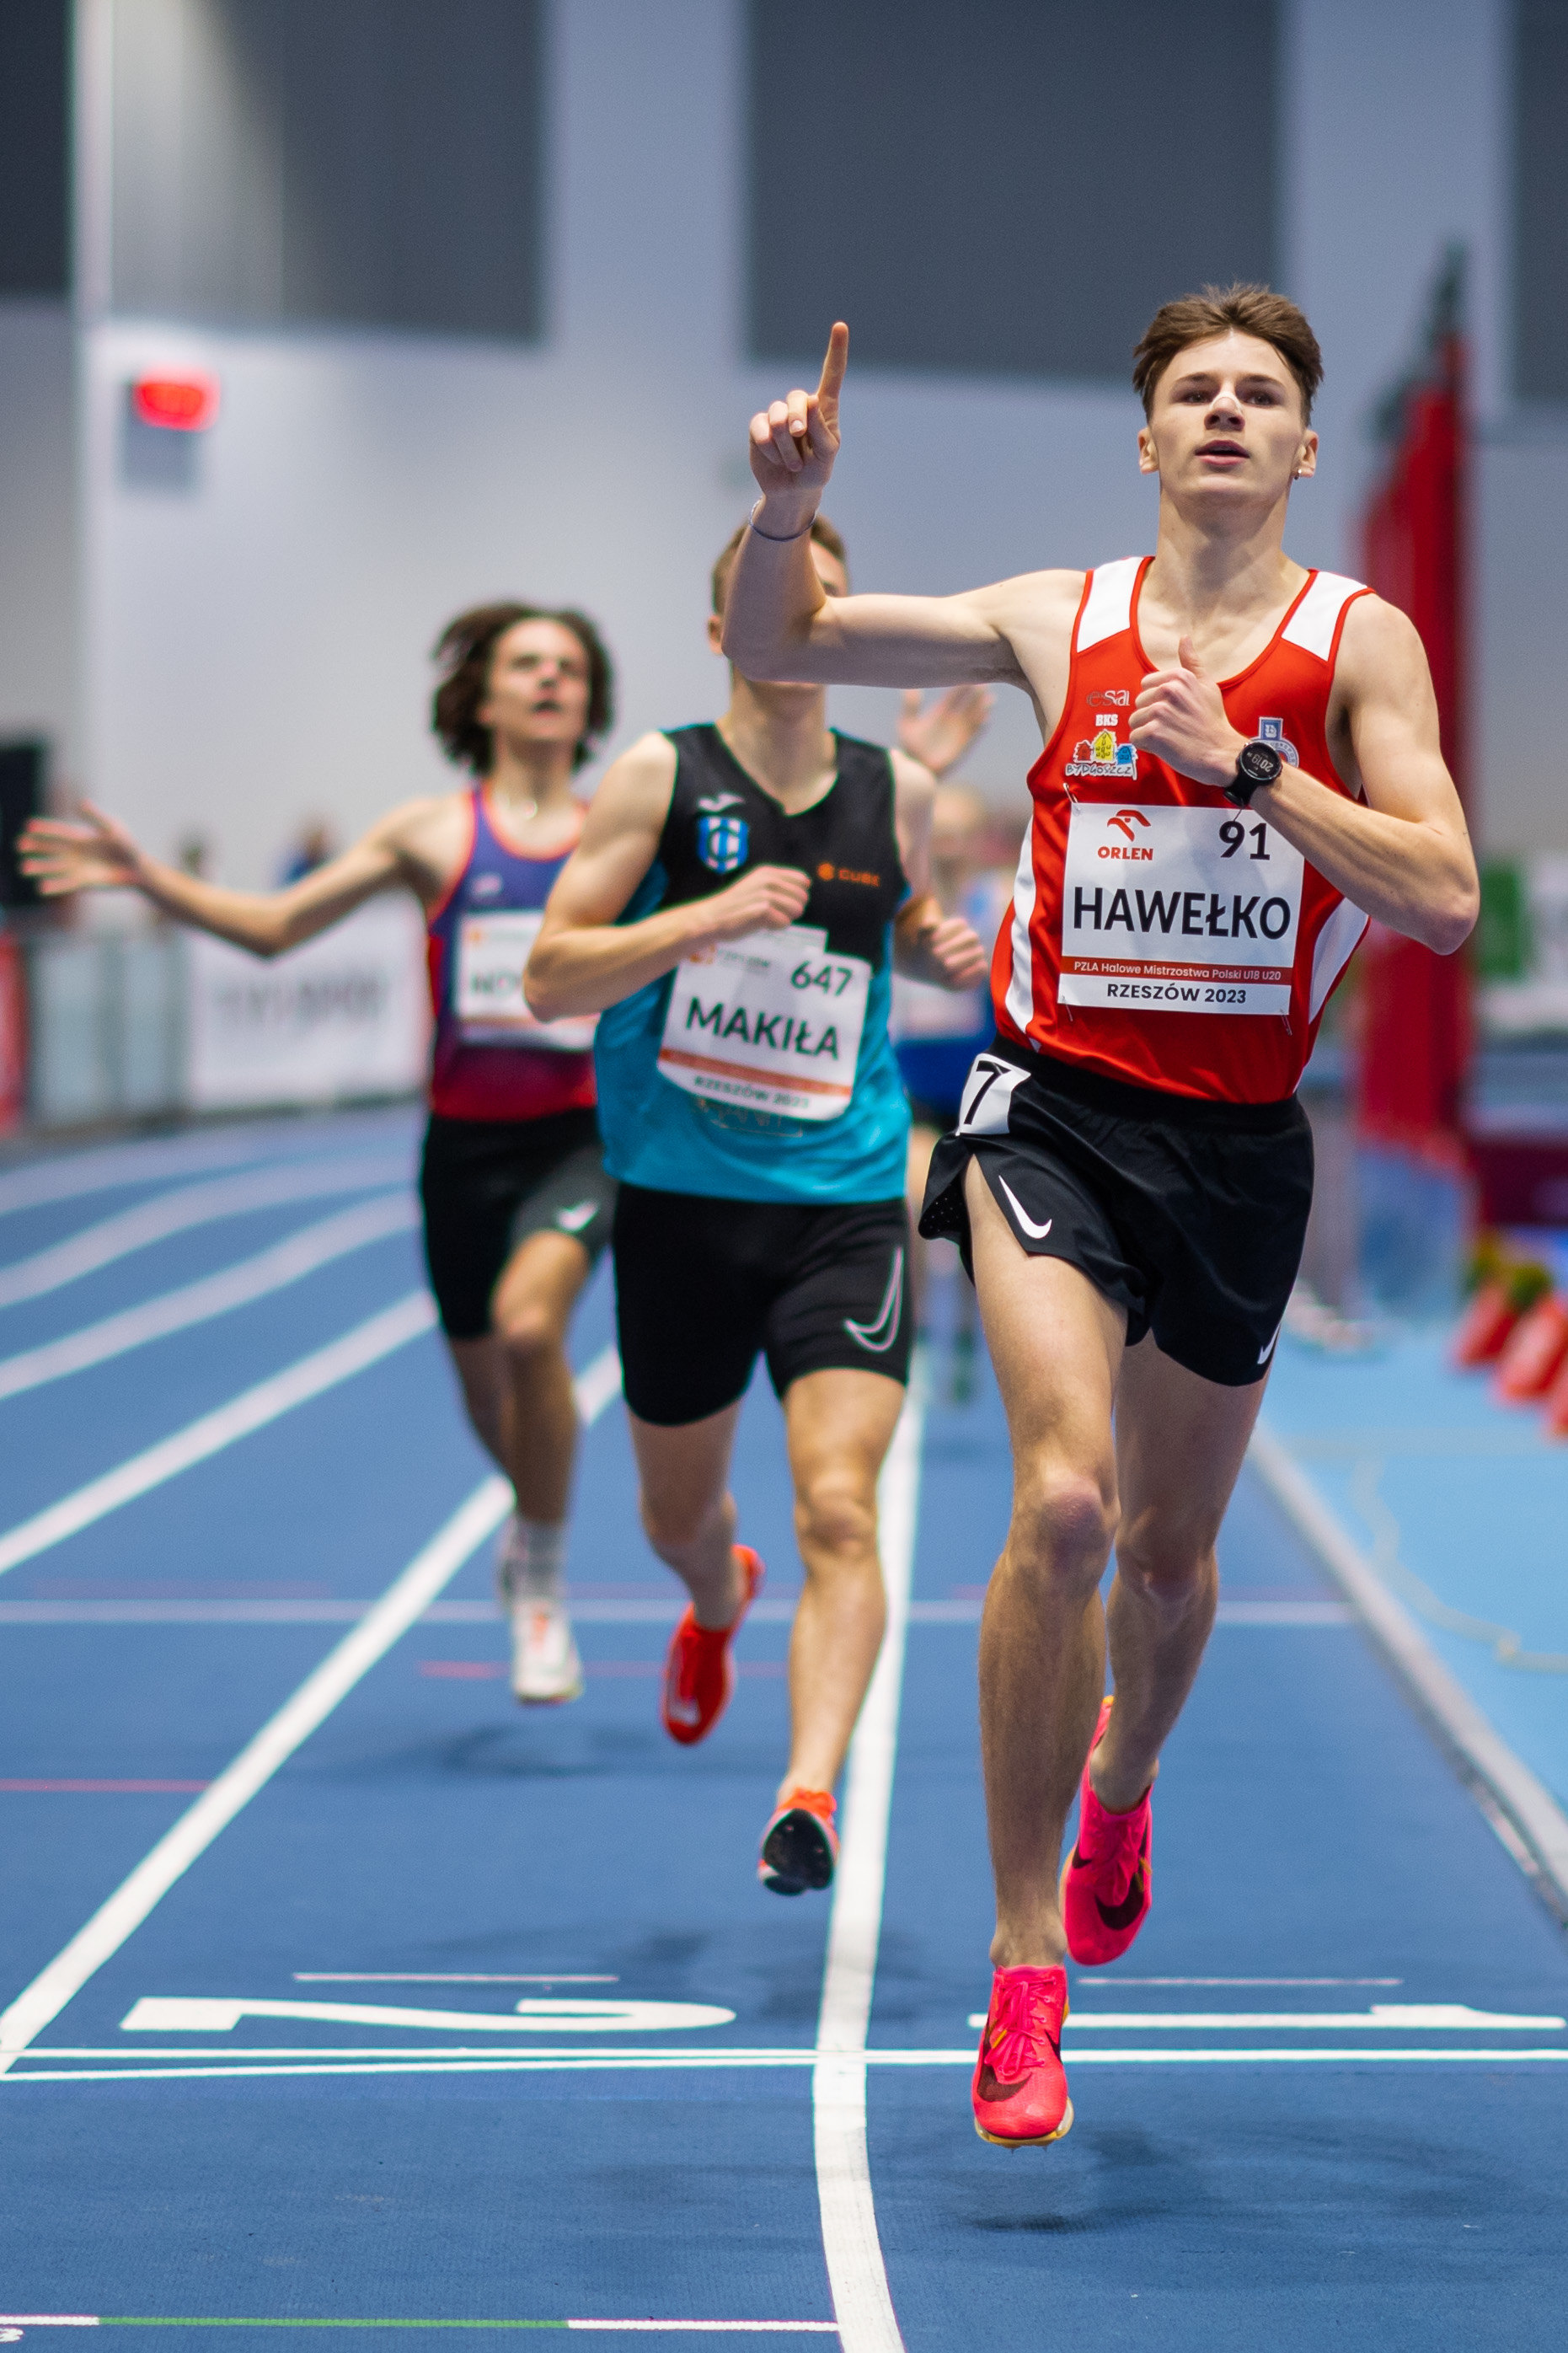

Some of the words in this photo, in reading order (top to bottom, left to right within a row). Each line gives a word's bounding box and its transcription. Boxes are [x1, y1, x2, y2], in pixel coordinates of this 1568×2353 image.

[1095, 714, 1118, 726] BKS
[1066, 763, 1133, 775] BYDGOSZCZ
[1097, 845, 1153, 860] ORLEN
[1218, 820, 1270, 860] 91
[1073, 886, 1291, 940] HAWEŁKO
[790, 960, 853, 997] 647
[1074, 961, 1099, 972] PZLA
[1101, 962, 1141, 974] Halowe
[1143, 965, 1210, 978] Mistrzostwa
[1212, 968, 1241, 980] Polski
[1243, 970, 1260, 980] U18
[1262, 971, 1282, 981] U20
[1107, 983, 1200, 1002] RZESZÓW
[1205, 989, 1246, 1004] 2023
[685, 995, 839, 1061] MAKIŁA
[963, 1059, 1012, 1125] 7
